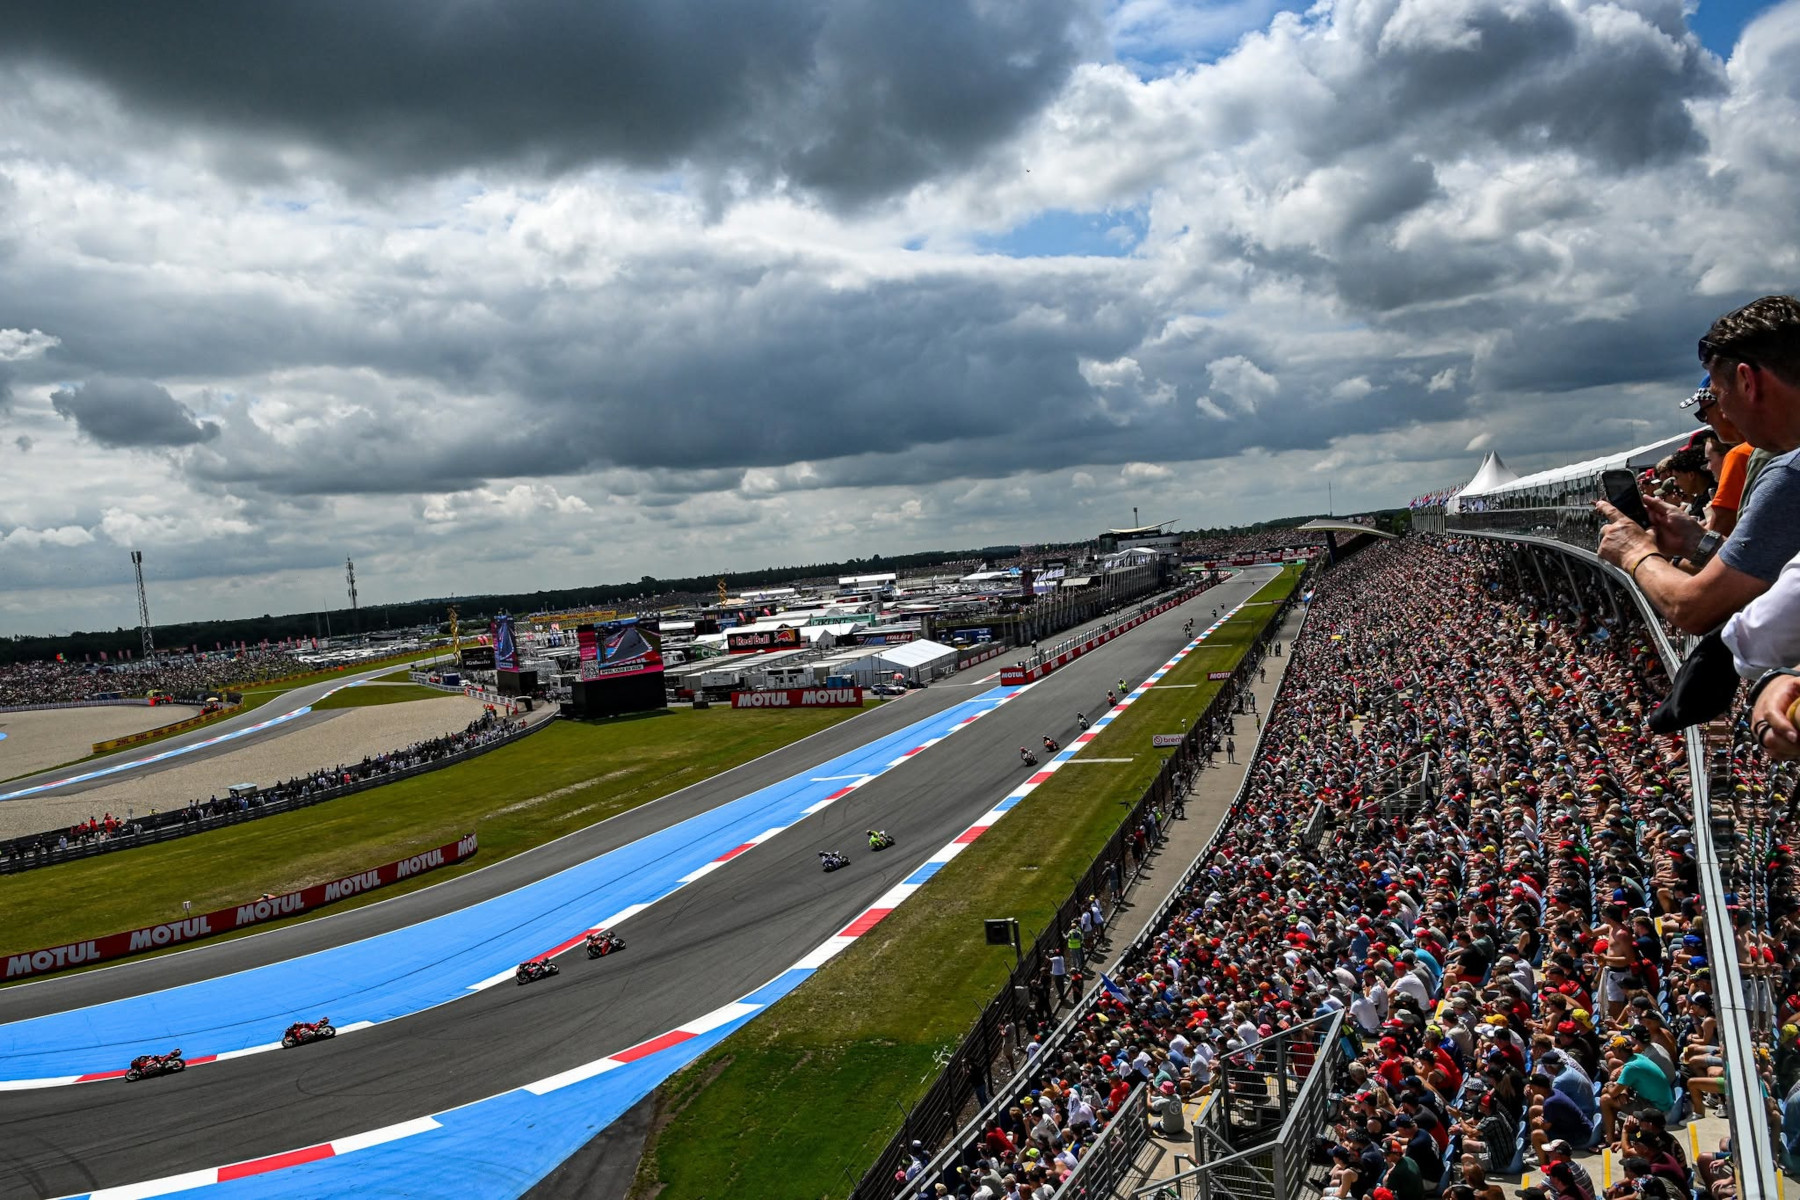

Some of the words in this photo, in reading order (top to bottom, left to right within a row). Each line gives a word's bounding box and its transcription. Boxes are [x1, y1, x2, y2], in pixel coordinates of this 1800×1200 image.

[736, 636, 753, 646] Red
[753, 633, 770, 645] Bull
[1001, 671, 1024, 679] MOTUL
[1210, 672, 1231, 680] MOTU
[738, 692, 790, 707] MOTUL
[801, 689, 857, 704] MOTUL
[6, 941, 100, 977] MOTUL
[129, 916, 212, 951] MOTUL
[236, 894, 304, 925] MOTUL
[325, 870, 381, 901] MOTUL
[397, 848, 444, 878] MOTUL
